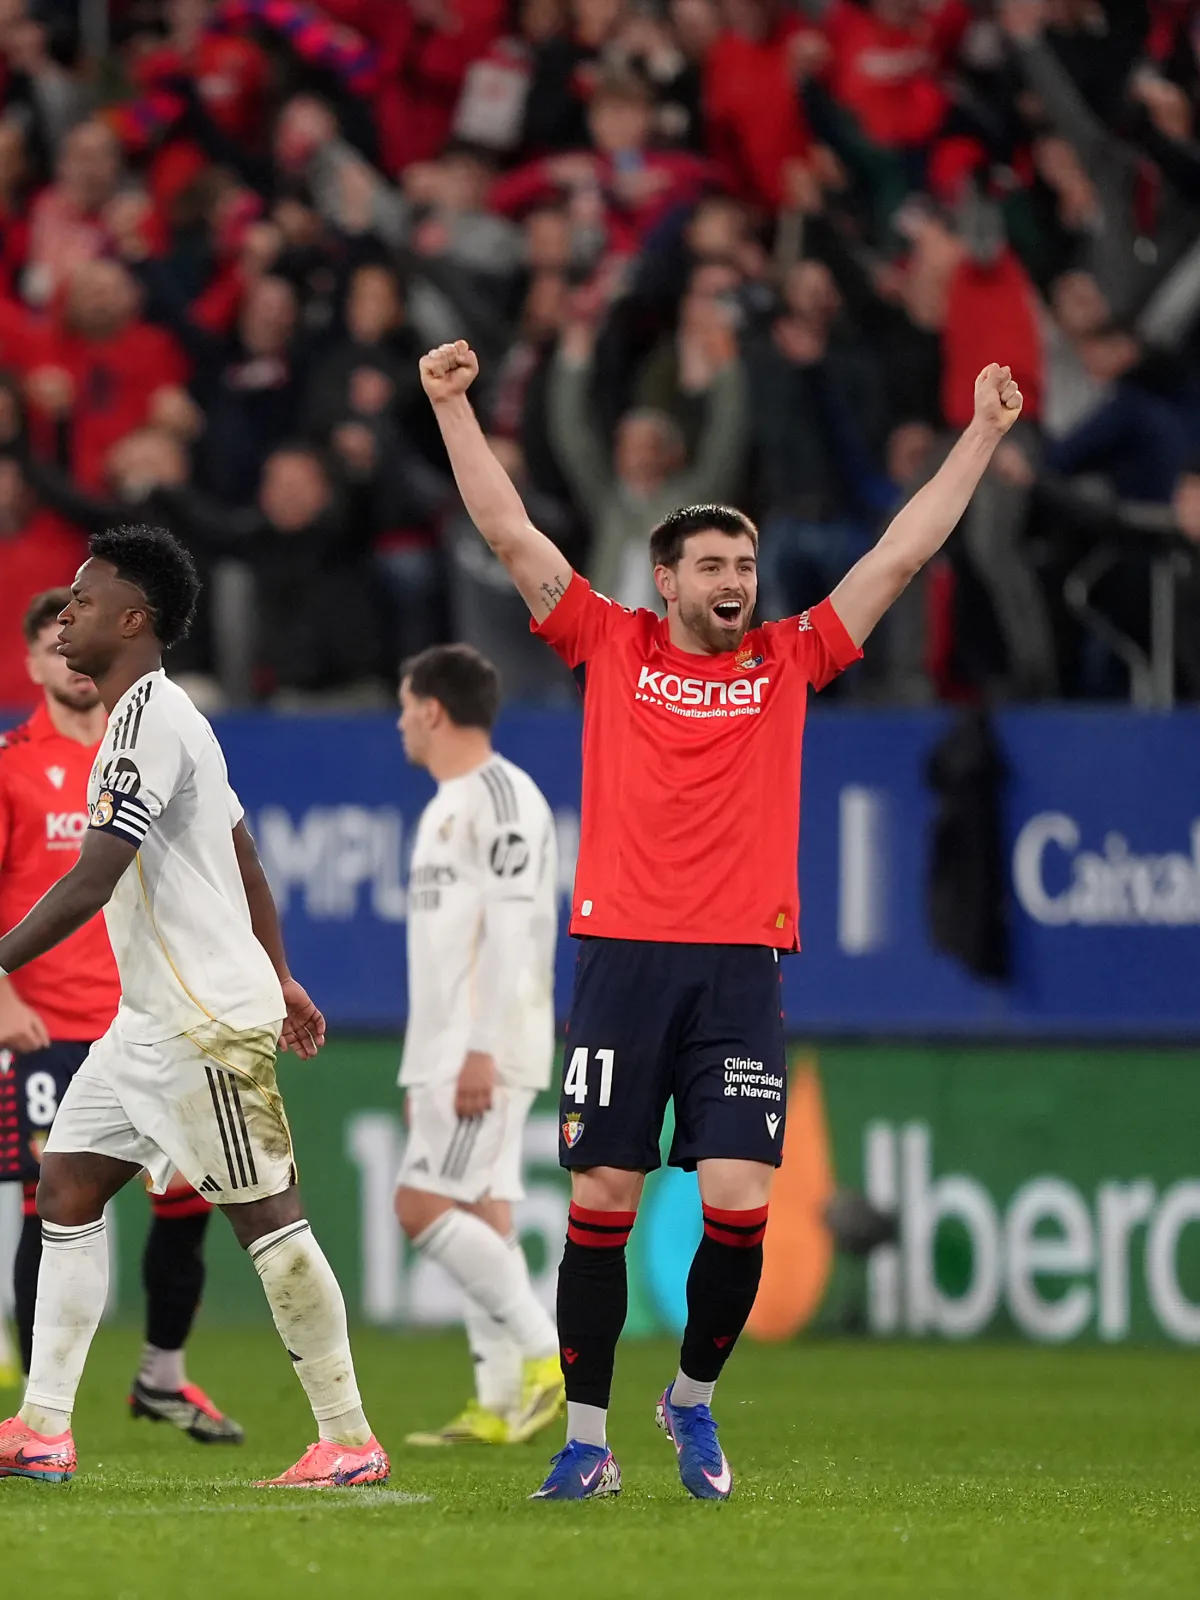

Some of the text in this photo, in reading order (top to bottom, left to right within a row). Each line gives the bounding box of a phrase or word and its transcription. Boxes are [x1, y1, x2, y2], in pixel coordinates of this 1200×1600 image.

[724, 1057, 763, 1070] Clínica
[564, 1047, 614, 1107] 41
[724, 1071, 783, 1088] Universidad
[25, 1071, 58, 1126] 8
[724, 1084, 781, 1101] de Navarra
